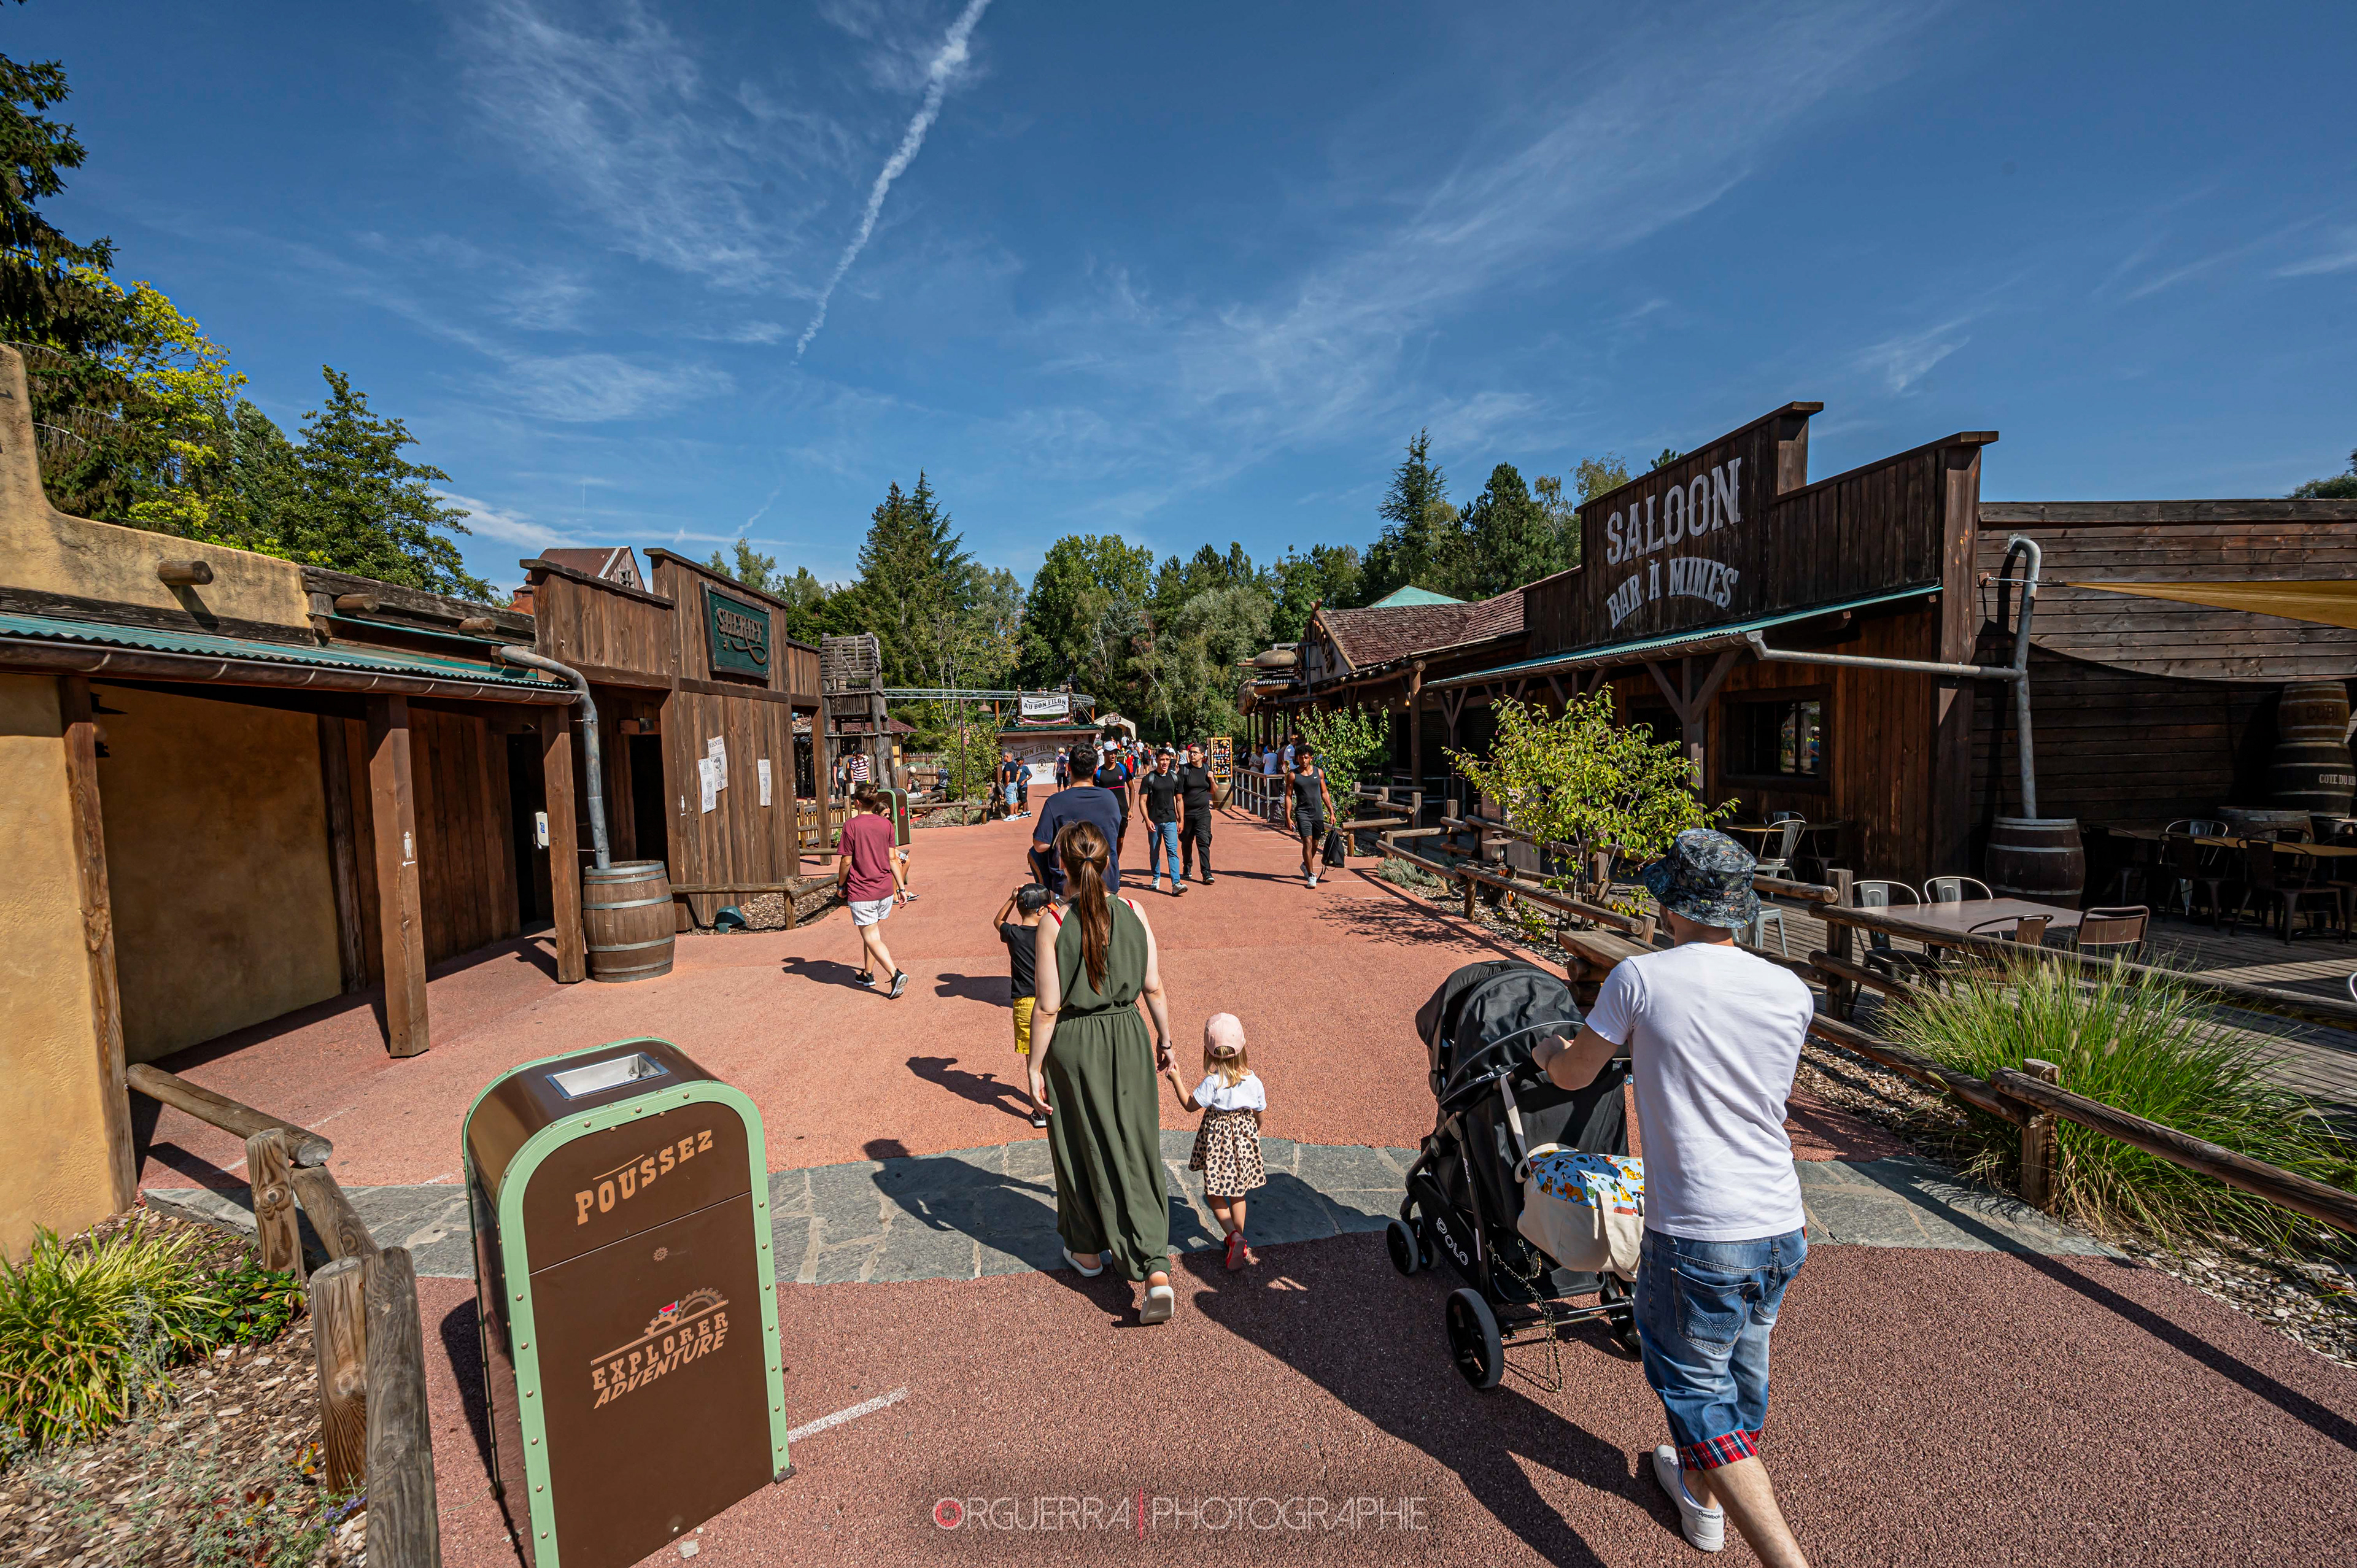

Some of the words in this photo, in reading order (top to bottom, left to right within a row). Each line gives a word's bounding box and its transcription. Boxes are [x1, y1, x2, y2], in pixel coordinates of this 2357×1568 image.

[1606, 457, 1741, 566] SALOON
[1606, 574, 1644, 630] BAR
[1649, 559, 1662, 601] À
[1668, 557, 1740, 610] MINES
[716, 607, 766, 663] SHERIFF
[1020, 748, 1034, 757] BON
[1036, 743, 1056, 753] FILON
[2319, 774, 2338, 784] COTE
[2339, 774, 2348, 785] DU
[575, 1129, 713, 1226] POUSSEZ
[592, 1311, 729, 1391] EXPLORER
[593, 1327, 729, 1410] ADVENTURE
[1698, 1510, 1720, 1519] Reebok
